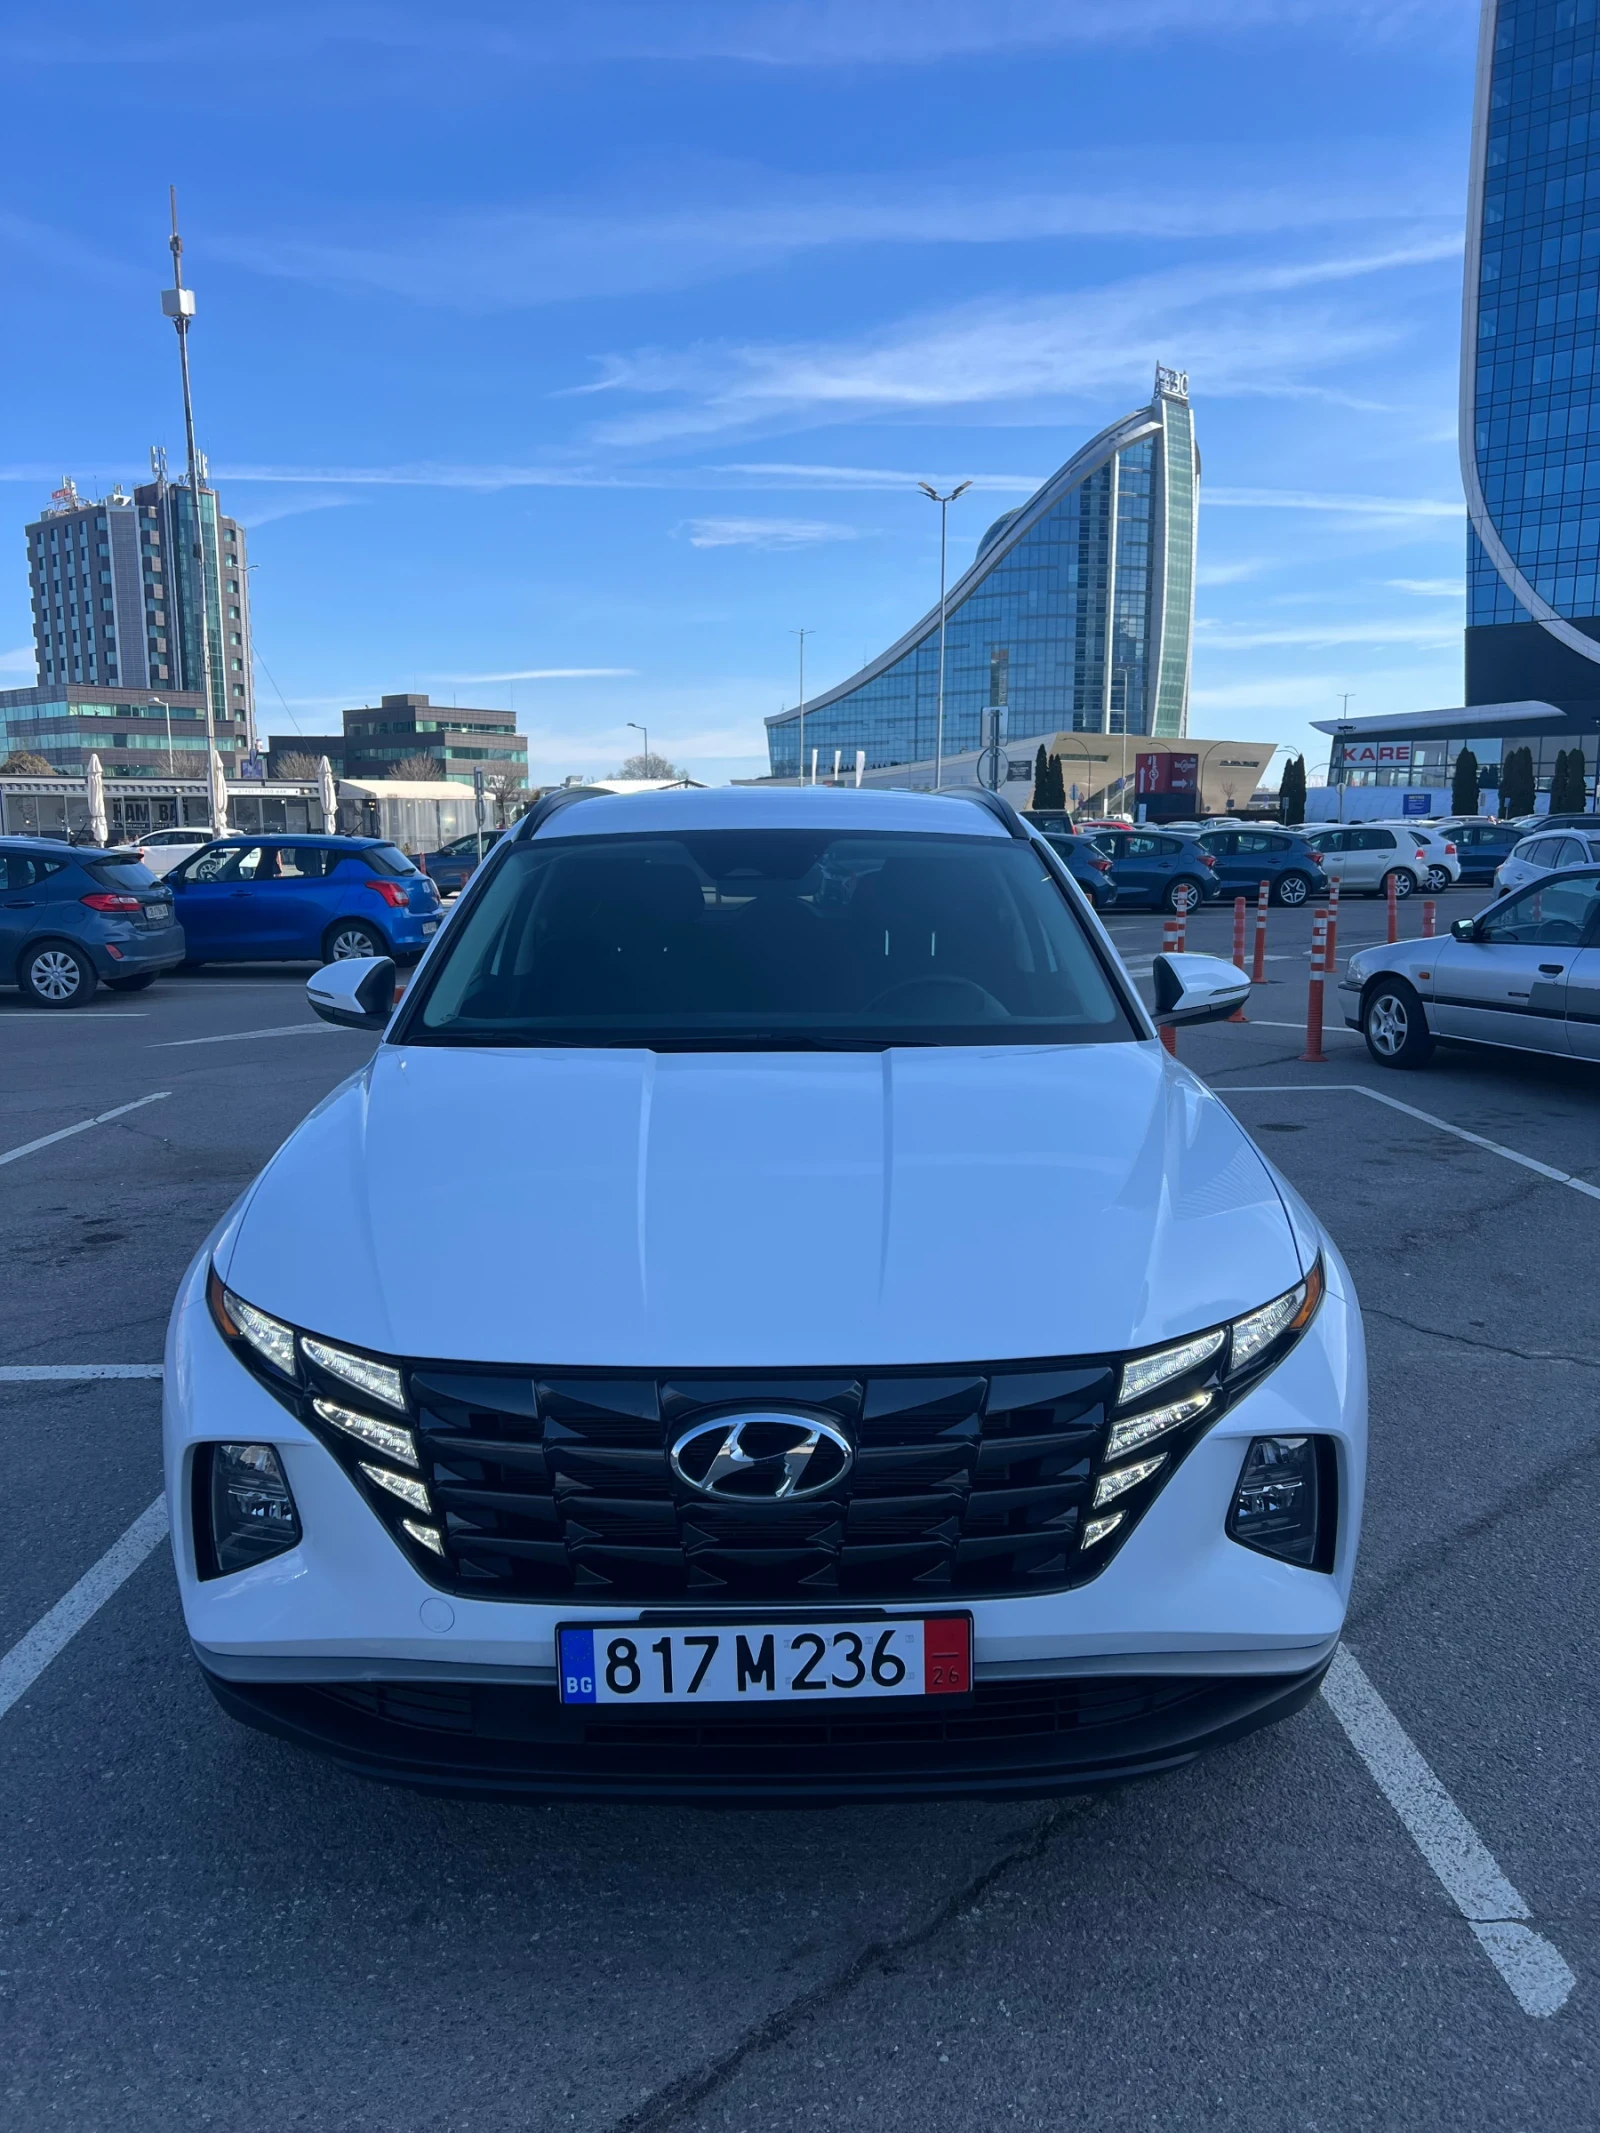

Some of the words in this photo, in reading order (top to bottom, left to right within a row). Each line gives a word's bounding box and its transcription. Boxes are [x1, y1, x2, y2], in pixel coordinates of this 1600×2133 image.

[1343, 747, 1410, 761] KARE
[113, 803, 149, 821] HAM
[605, 1636, 719, 1694] 817
[736, 1634, 775, 1692] M
[791, 1630, 906, 1690] 236
[933, 1665, 960, 1685] 26
[566, 1677, 592, 1693] BG
